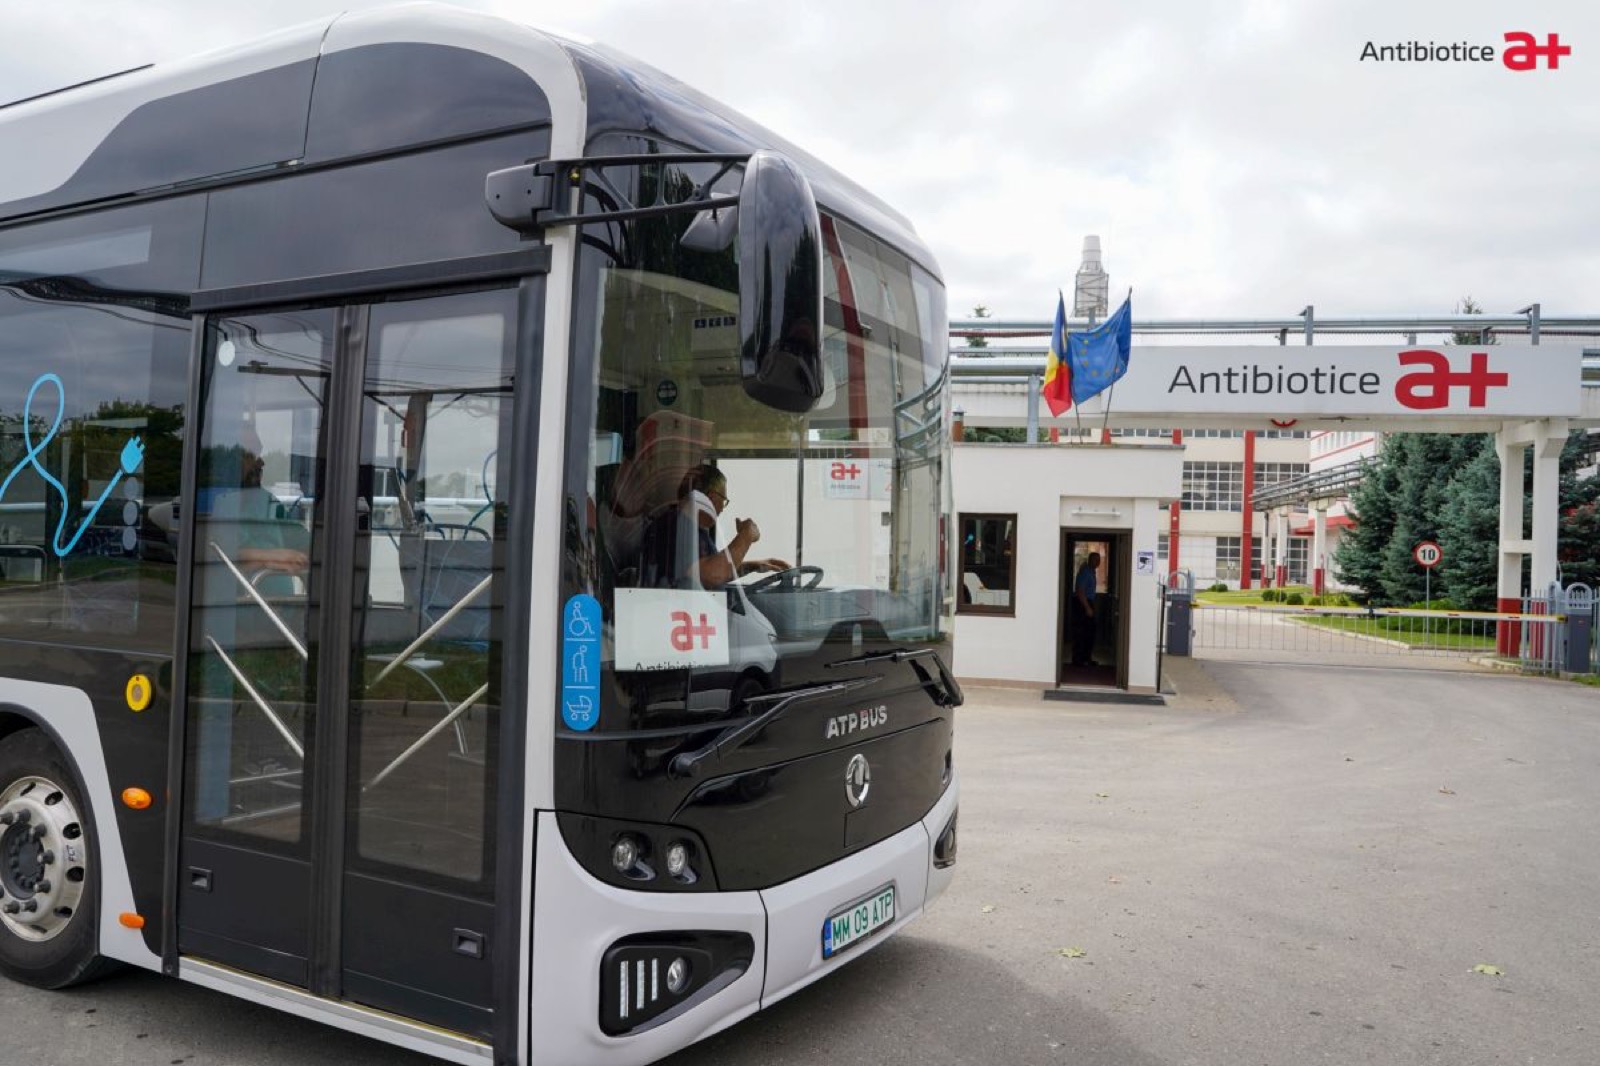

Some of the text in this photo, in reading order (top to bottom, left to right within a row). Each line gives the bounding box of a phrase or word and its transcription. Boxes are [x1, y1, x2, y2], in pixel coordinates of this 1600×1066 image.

[1168, 365, 1381, 394] Antibiotice
[1421, 549, 1436, 561] 10
[826, 705, 888, 739] ATP BUS
[832, 892, 893, 947] MM 09 ATP
